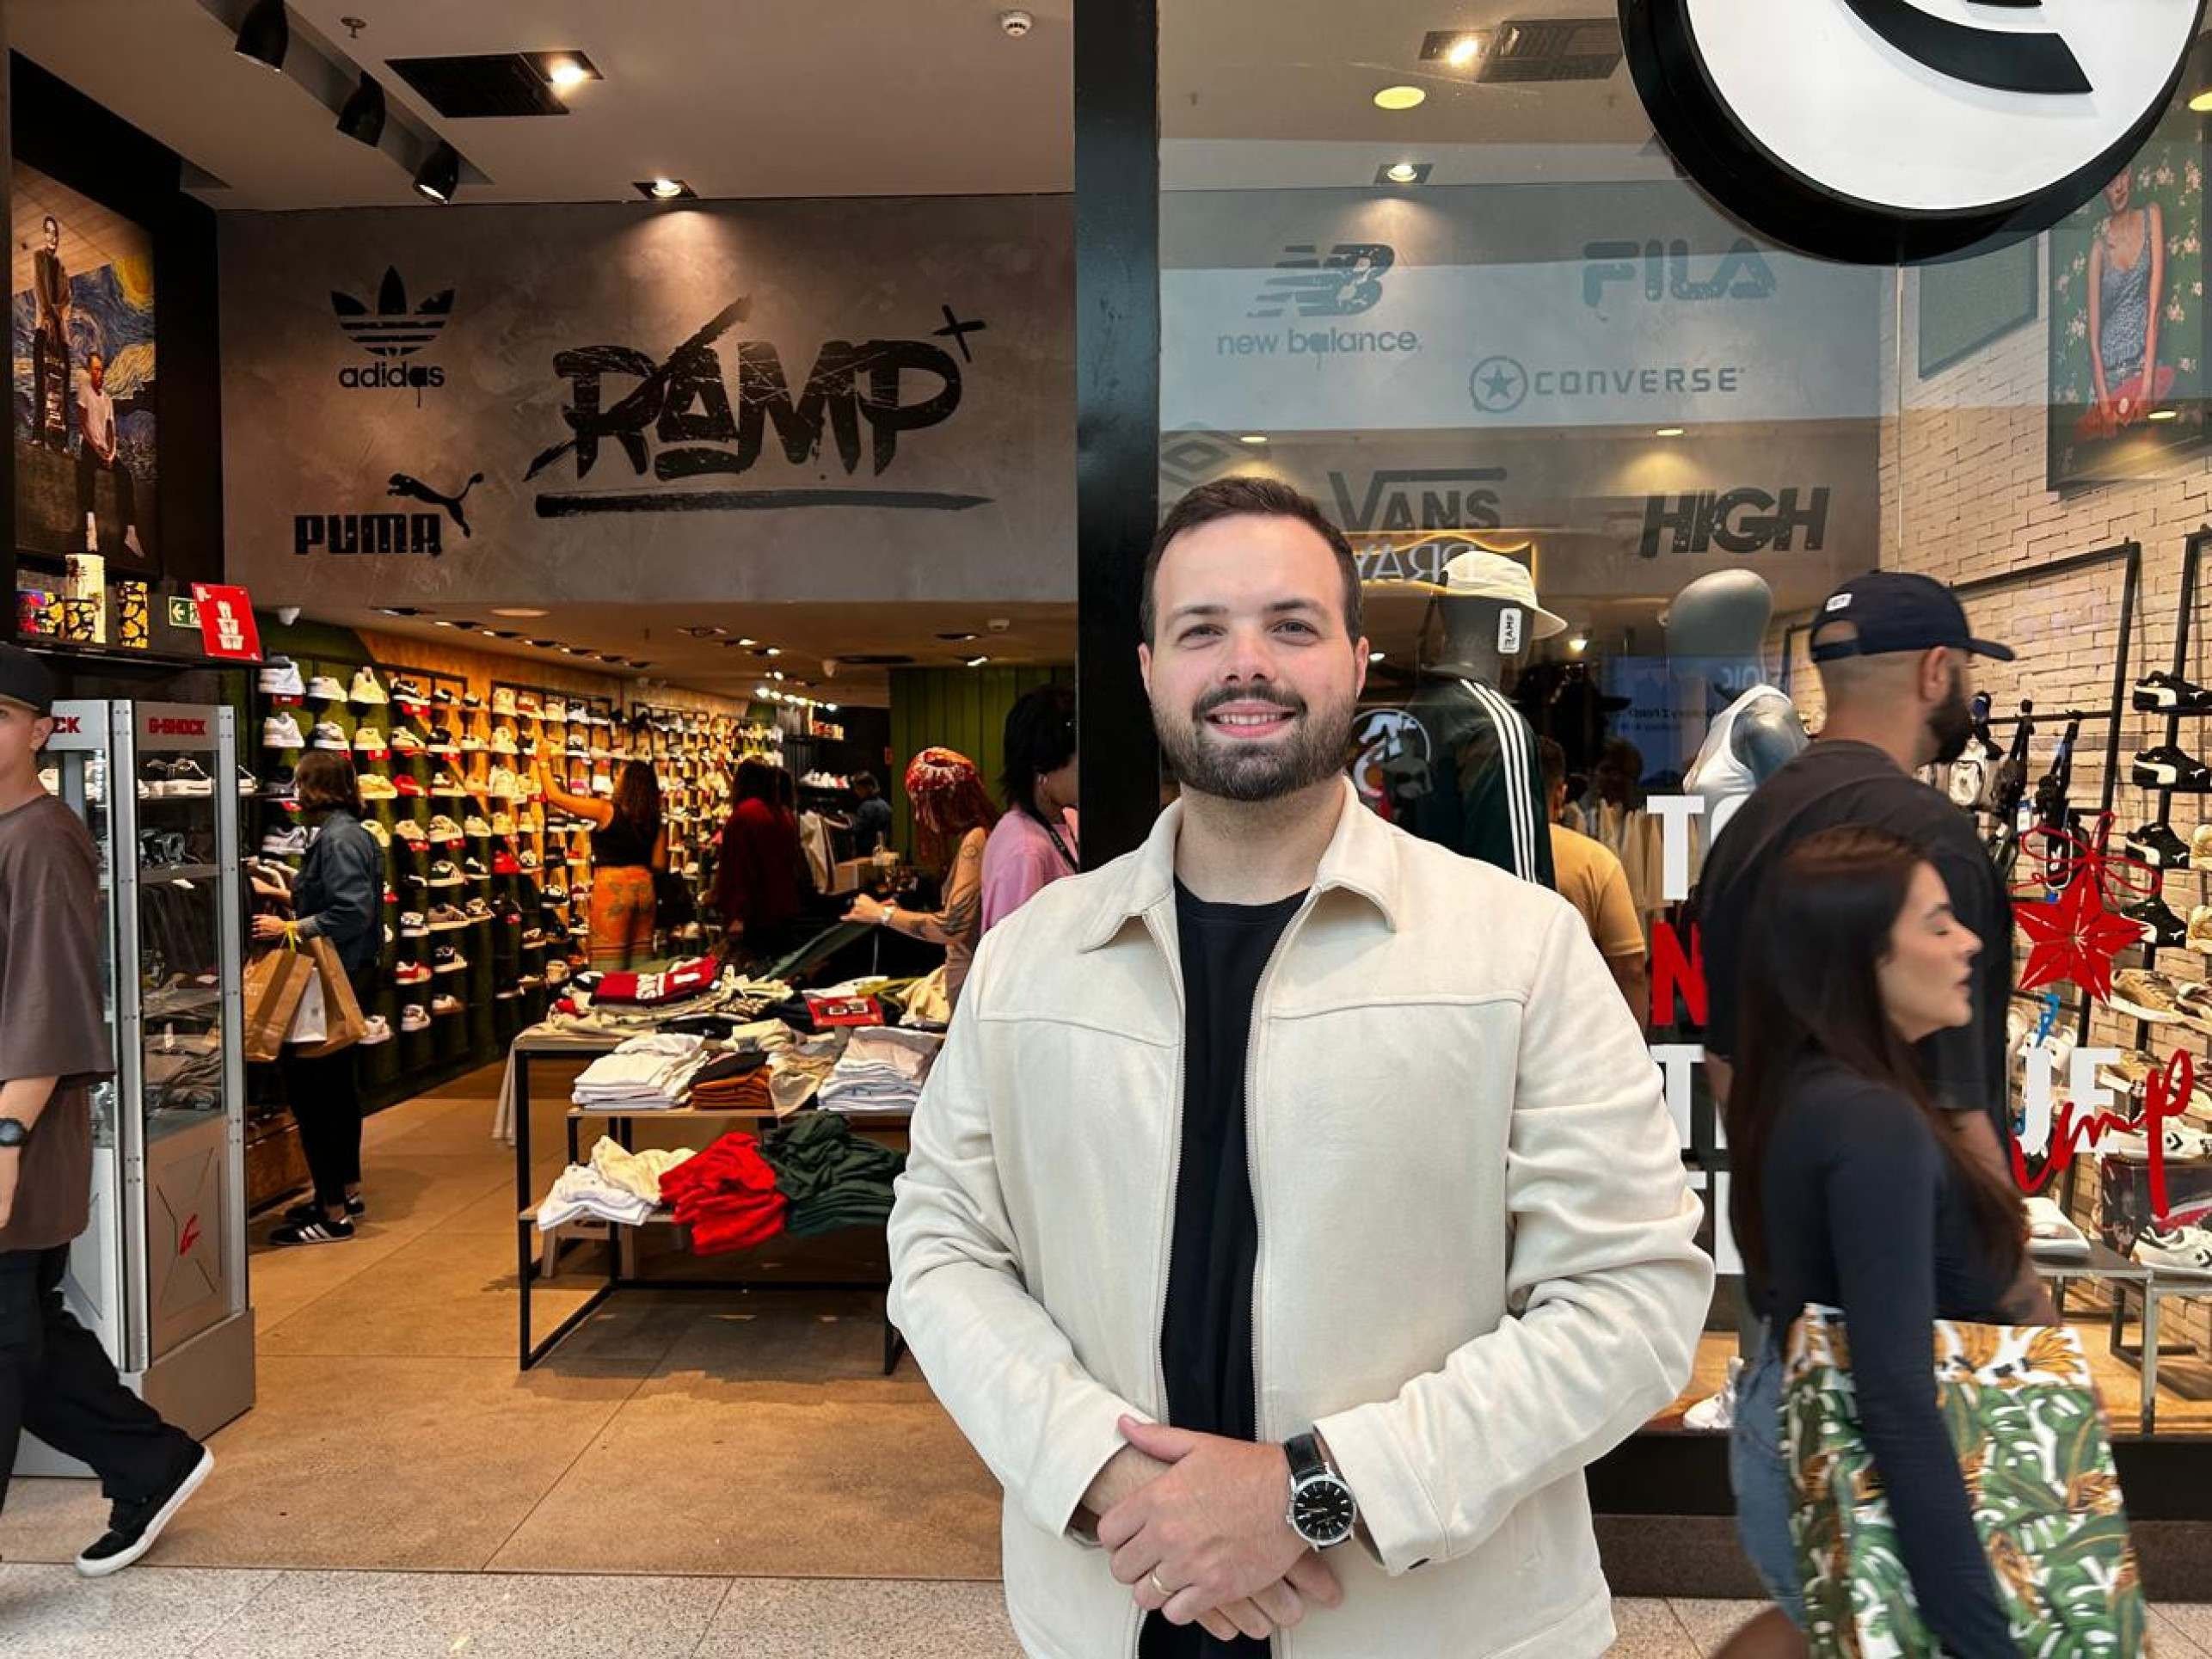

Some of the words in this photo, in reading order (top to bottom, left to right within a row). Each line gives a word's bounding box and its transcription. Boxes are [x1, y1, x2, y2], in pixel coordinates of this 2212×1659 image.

[1583, 238, 1777, 308] FILA
[1217, 330, 1279, 354] new
[1287, 327, 1418, 354] balance
[338, 361, 445, 388] adidas
[1534, 367, 1739, 395] CONVERSE
[1328, 467, 1507, 535] VANS
[295, 513, 442, 556] PUMA
[1640, 488, 1831, 558] HIGH
[149, 718, 206, 735] G-SHOCK
